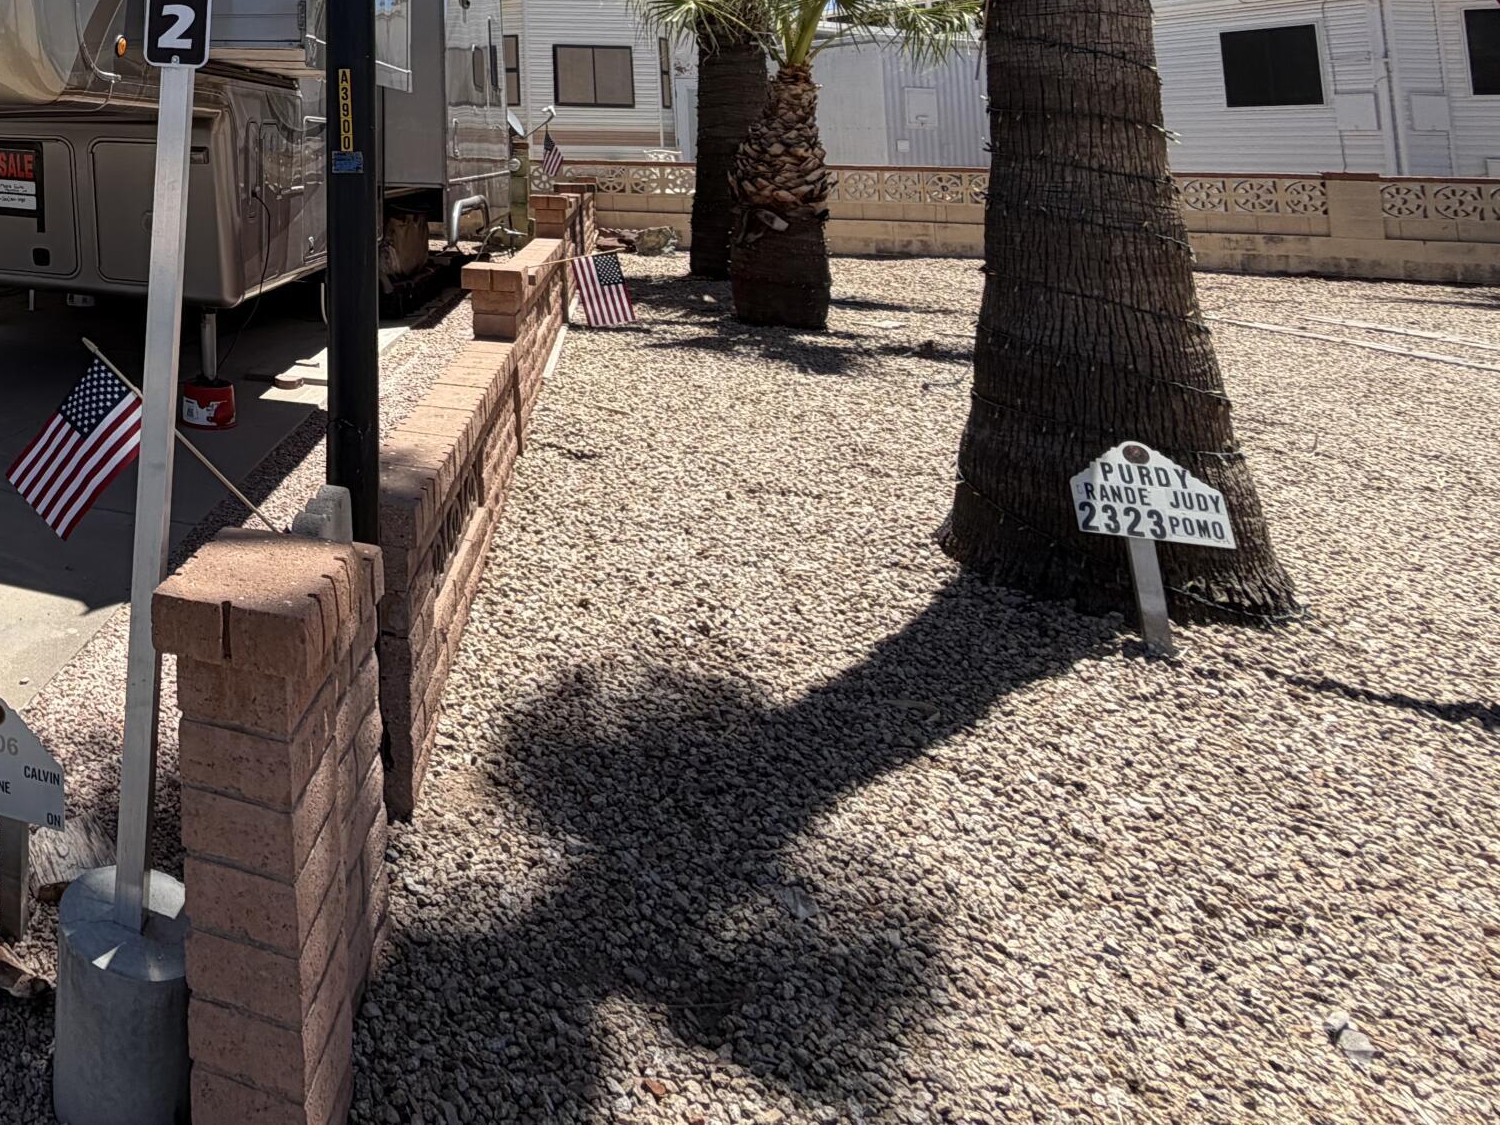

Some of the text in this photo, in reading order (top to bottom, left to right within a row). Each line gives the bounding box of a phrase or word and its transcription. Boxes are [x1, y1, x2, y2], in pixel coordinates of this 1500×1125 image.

[340, 69, 351, 150] A3900
[1100, 461, 1189, 490] PURDY
[1169, 490, 1221, 514] JUDY
[1078, 501, 1226, 540] 2323 POMO
[23, 765, 60, 786] CALVIN
[46, 812, 61, 827] ON
